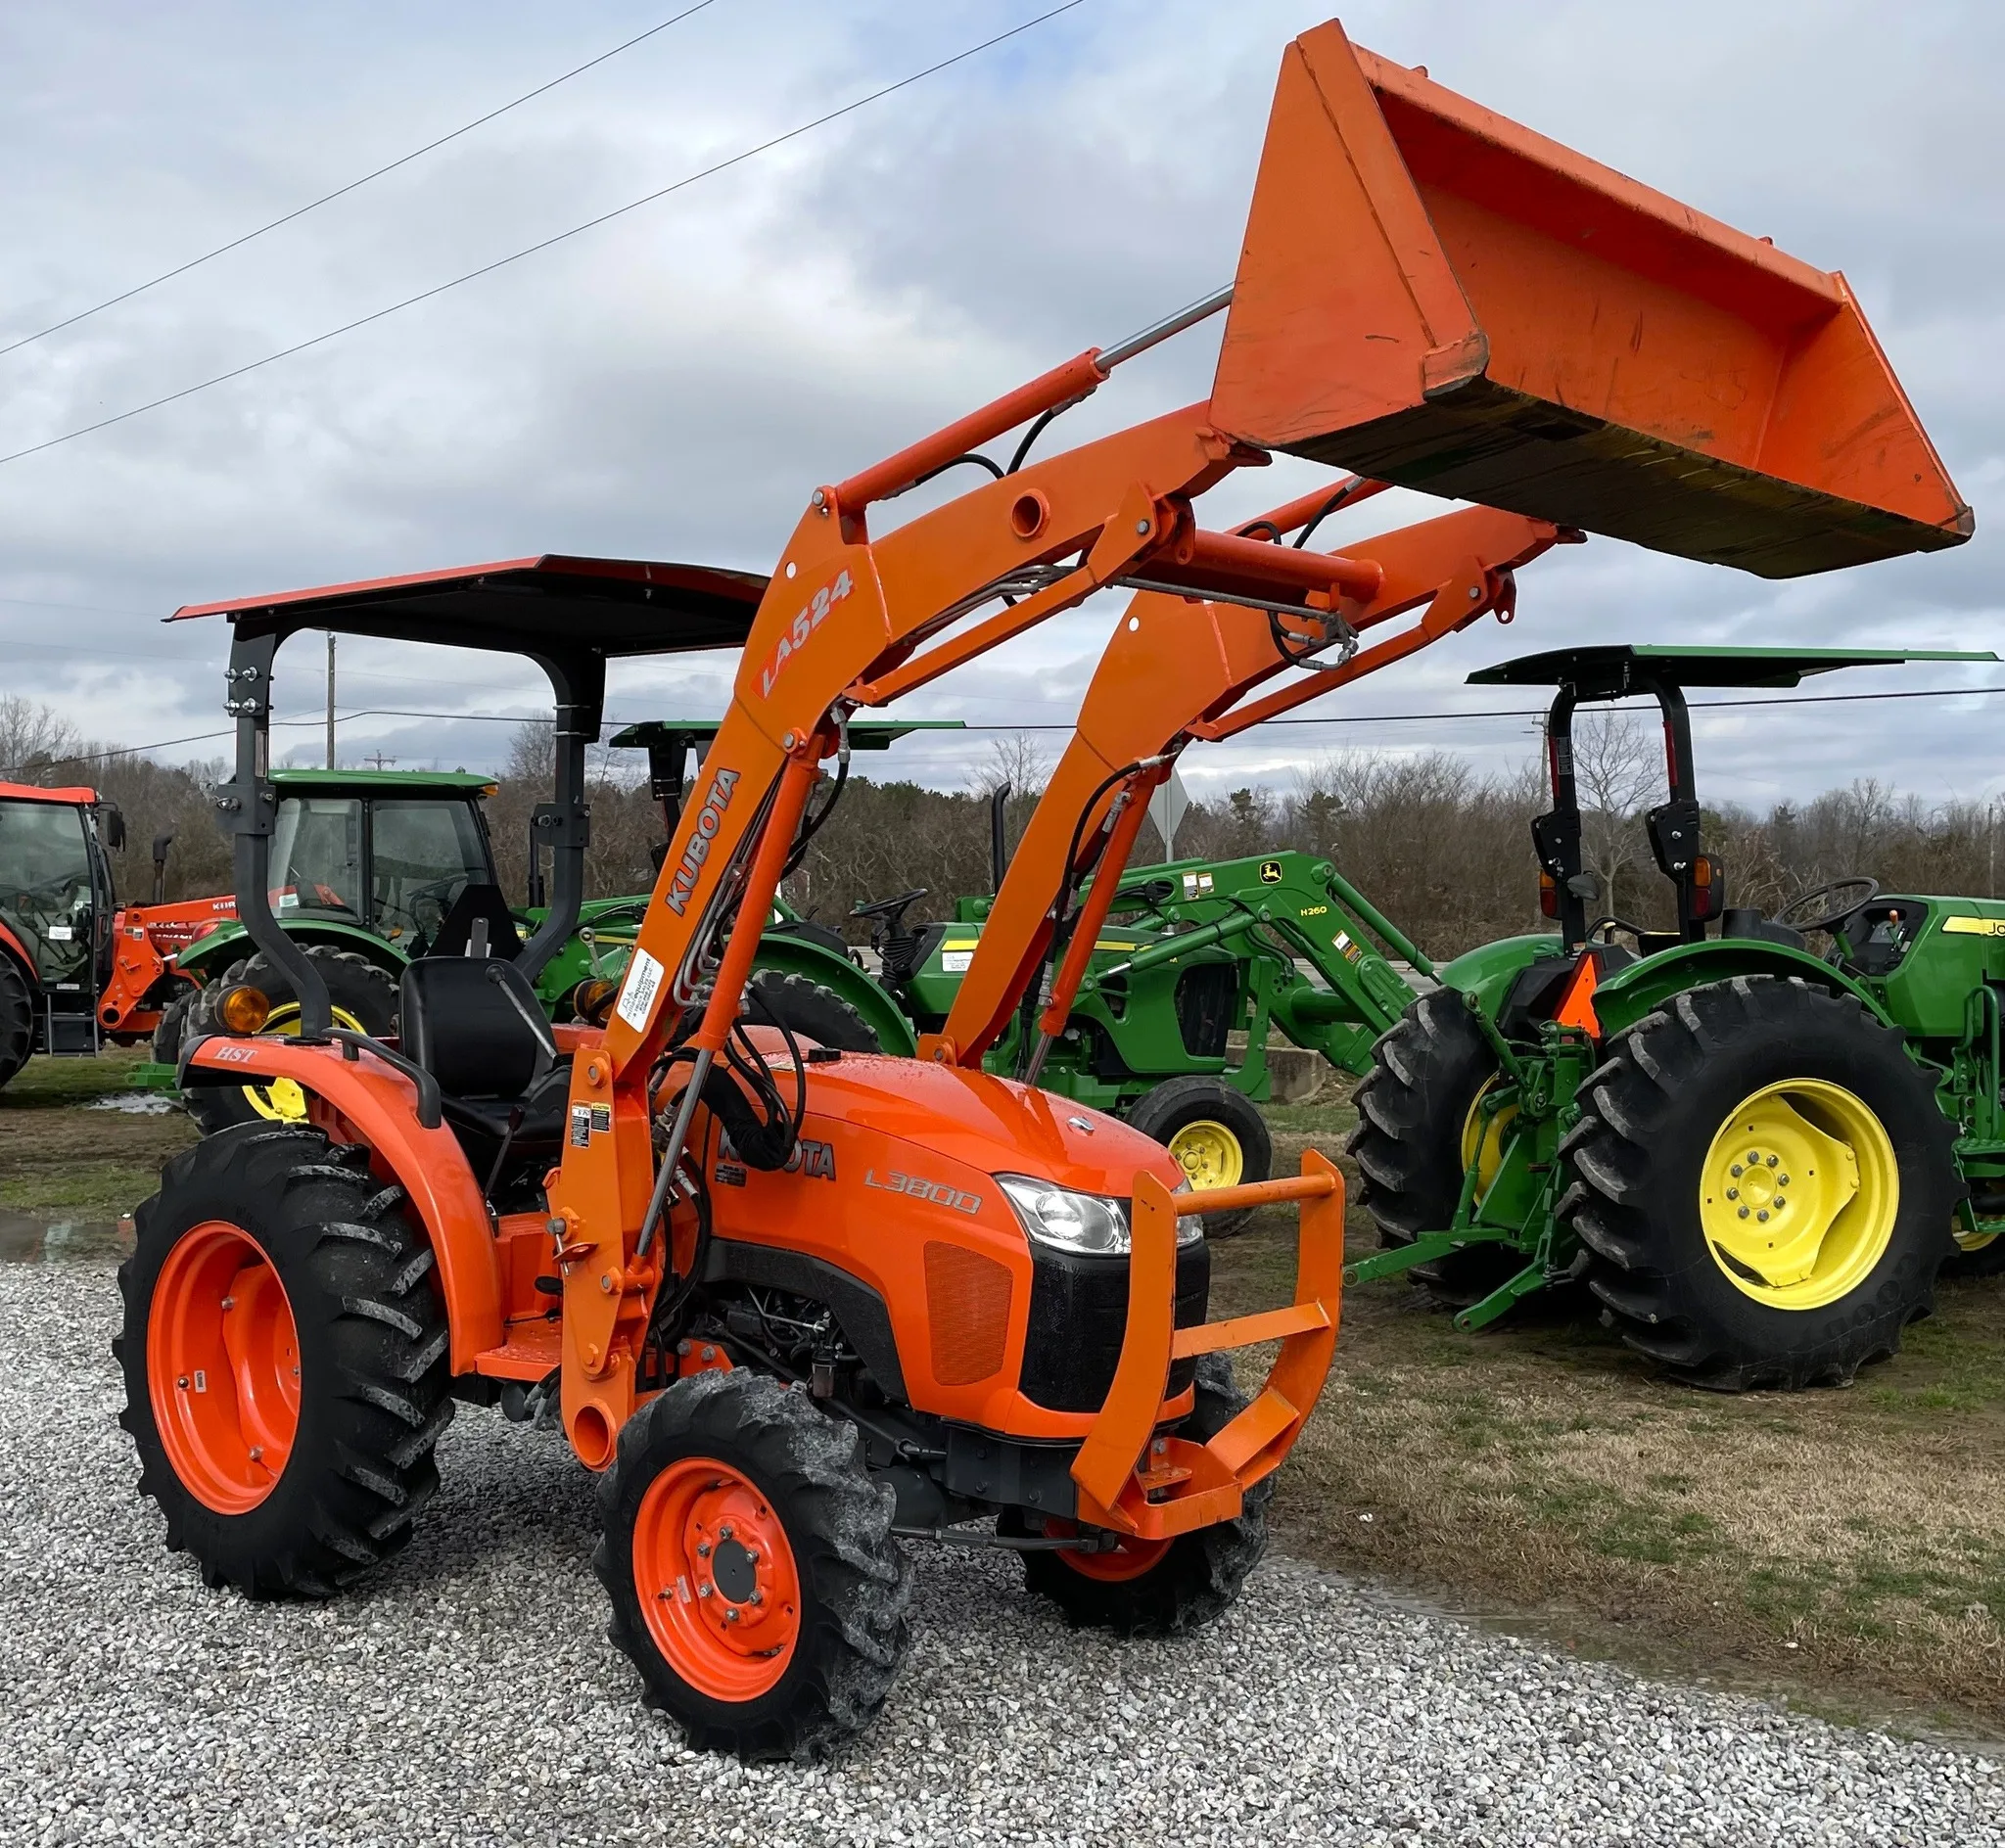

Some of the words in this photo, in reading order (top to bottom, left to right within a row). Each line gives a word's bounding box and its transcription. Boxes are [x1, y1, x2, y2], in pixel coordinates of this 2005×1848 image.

[762, 569, 854, 699] LA524
[665, 767, 741, 917] KUBOTA
[1300, 905, 1328, 916] H260
[213, 1046, 258, 1063] HST
[718, 1125, 836, 1181] KOTA
[863, 1168, 983, 1215] L3800
